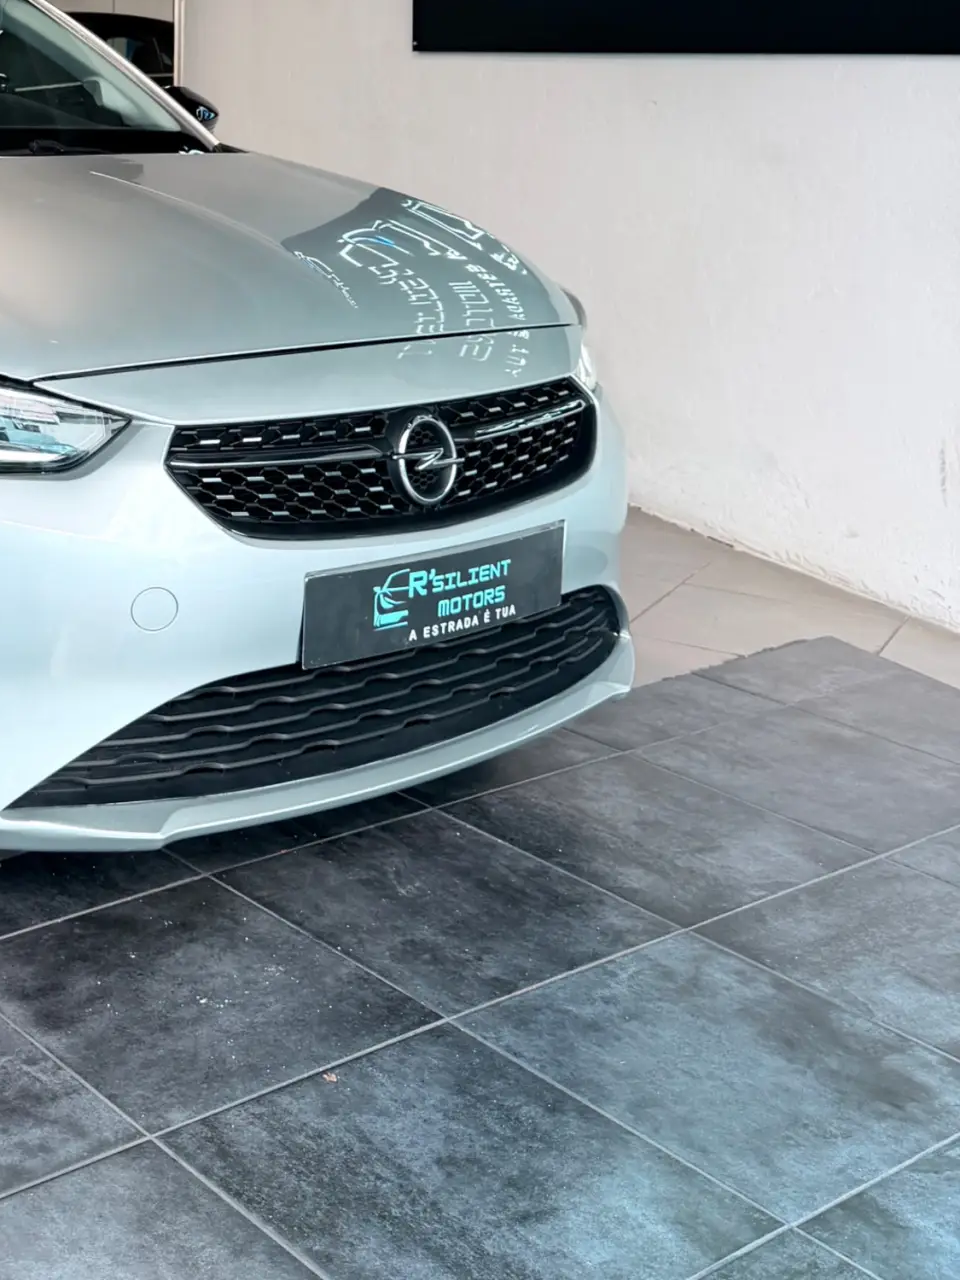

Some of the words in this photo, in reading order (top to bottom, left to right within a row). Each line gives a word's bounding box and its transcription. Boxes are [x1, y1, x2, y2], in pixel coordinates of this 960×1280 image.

[437, 585, 506, 617] MOTORS
[408, 629, 418, 641] A
[423, 617, 479, 638] ESTRADA
[495, 604, 517, 620] TUA
